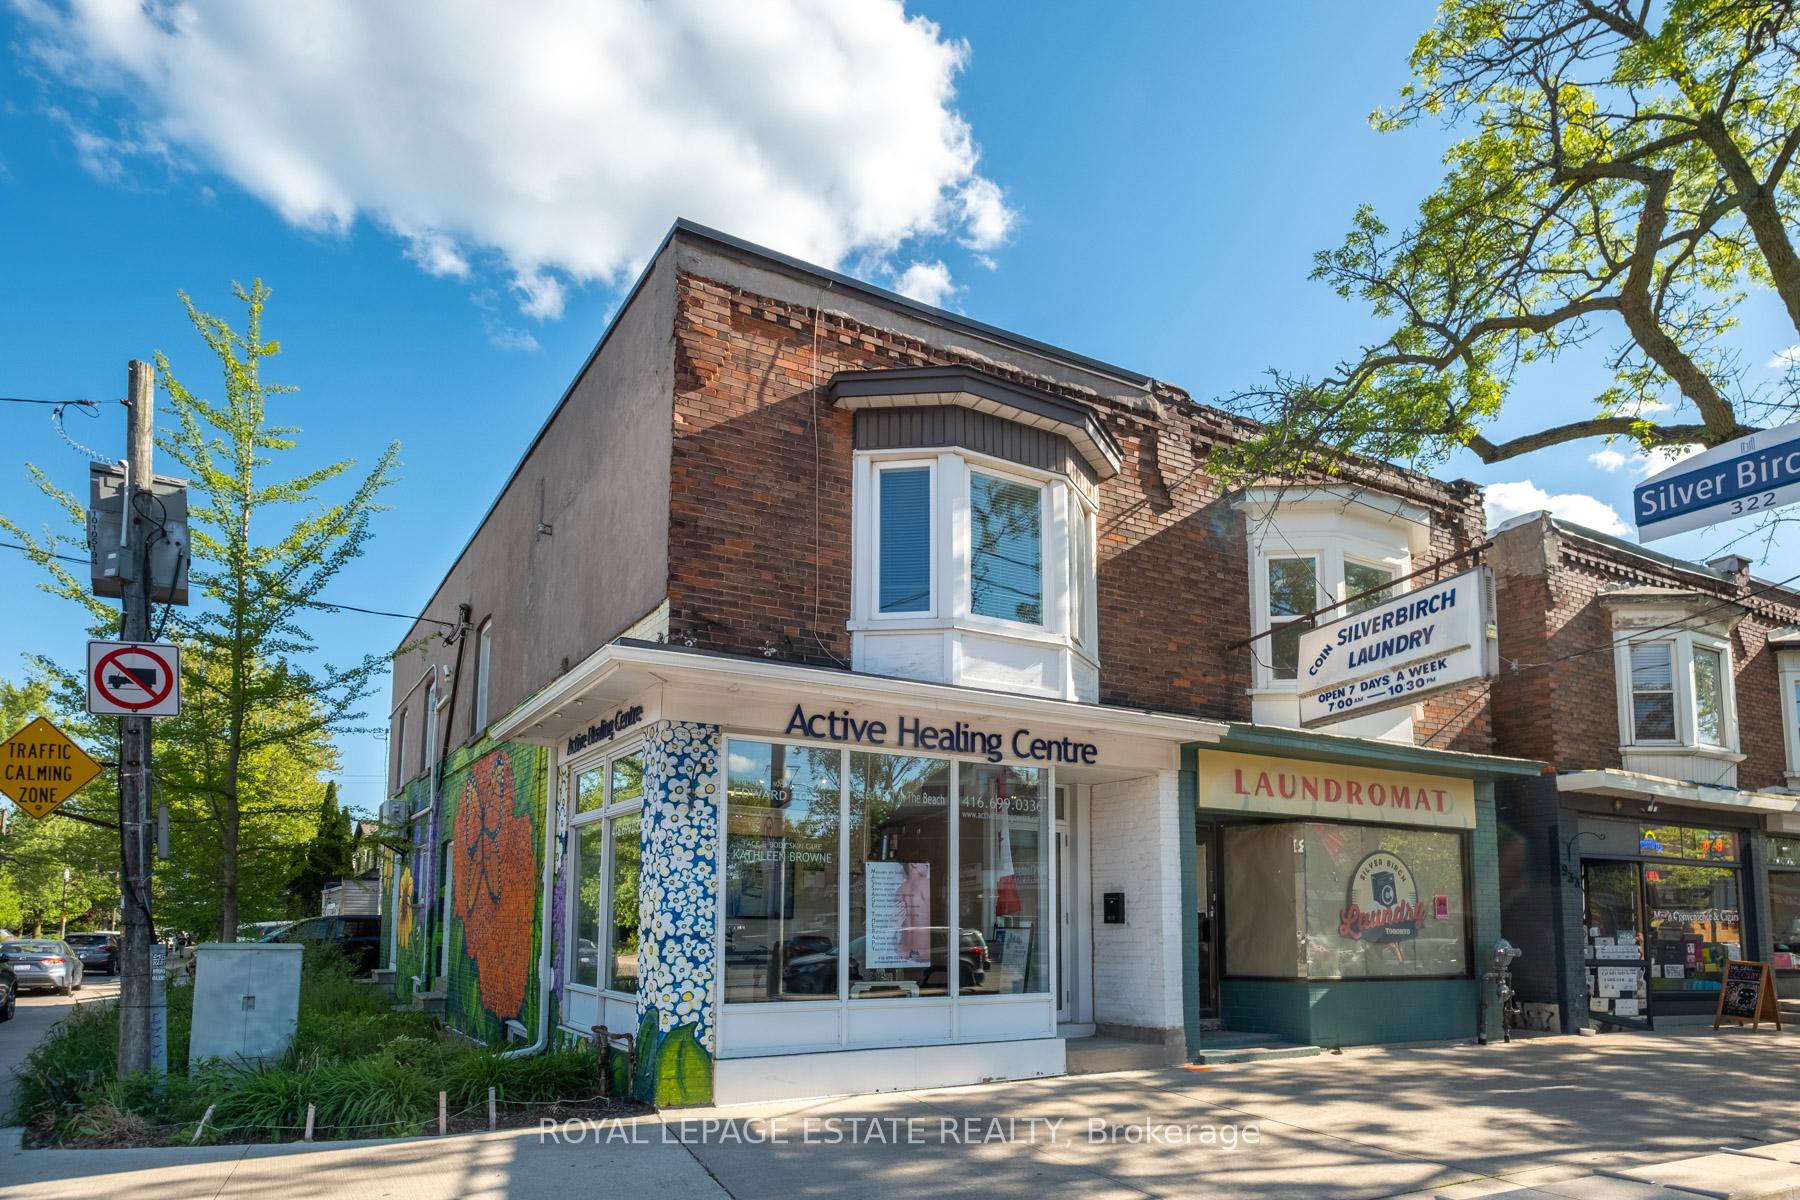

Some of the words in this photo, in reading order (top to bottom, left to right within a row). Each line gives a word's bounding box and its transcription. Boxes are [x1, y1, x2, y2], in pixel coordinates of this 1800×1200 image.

[1641, 473, 1726, 516] Silver
[1731, 492, 1776, 515] 322
[1337, 588, 1457, 646] SILVERBIRCH
[1348, 625, 1435, 669] LAUNDRY
[1309, 644, 1333, 676] COIN
[1318, 687, 1345, 703] OPEN
[1349, 685, 1356, 695] 7
[1360, 675, 1390, 691] DAYS
[1396, 671, 1405, 682] A
[1408, 658, 1448, 677] WEEK
[587, 719, 615, 746] Healing
[614, 705, 644, 731] Centre
[785, 703, 887, 745] Active
[898, 715, 1003, 763] Healing
[1012, 728, 1098, 765] Centre
[9, 743, 71, 759] TRAFFIC
[5, 765, 72, 781] CALMING
[19, 787, 57, 803] ZONE
[734, 787, 788, 801] EDWARD
[922, 792, 945, 805] Beach
[1234, 768, 1448, 813] LAUNDROMAT
[962, 796, 1042, 812] 416.699.0336
[733, 848, 785, 861] KATHLEEN
[789, 851, 833, 864] BROWNE
[1360, 858, 1383, 881] SILVER
[1386, 860, 1407, 882] BIRCH
[1338, 899, 1426, 941] Laundry
[1385, 927, 1411, 935] TORONTO
